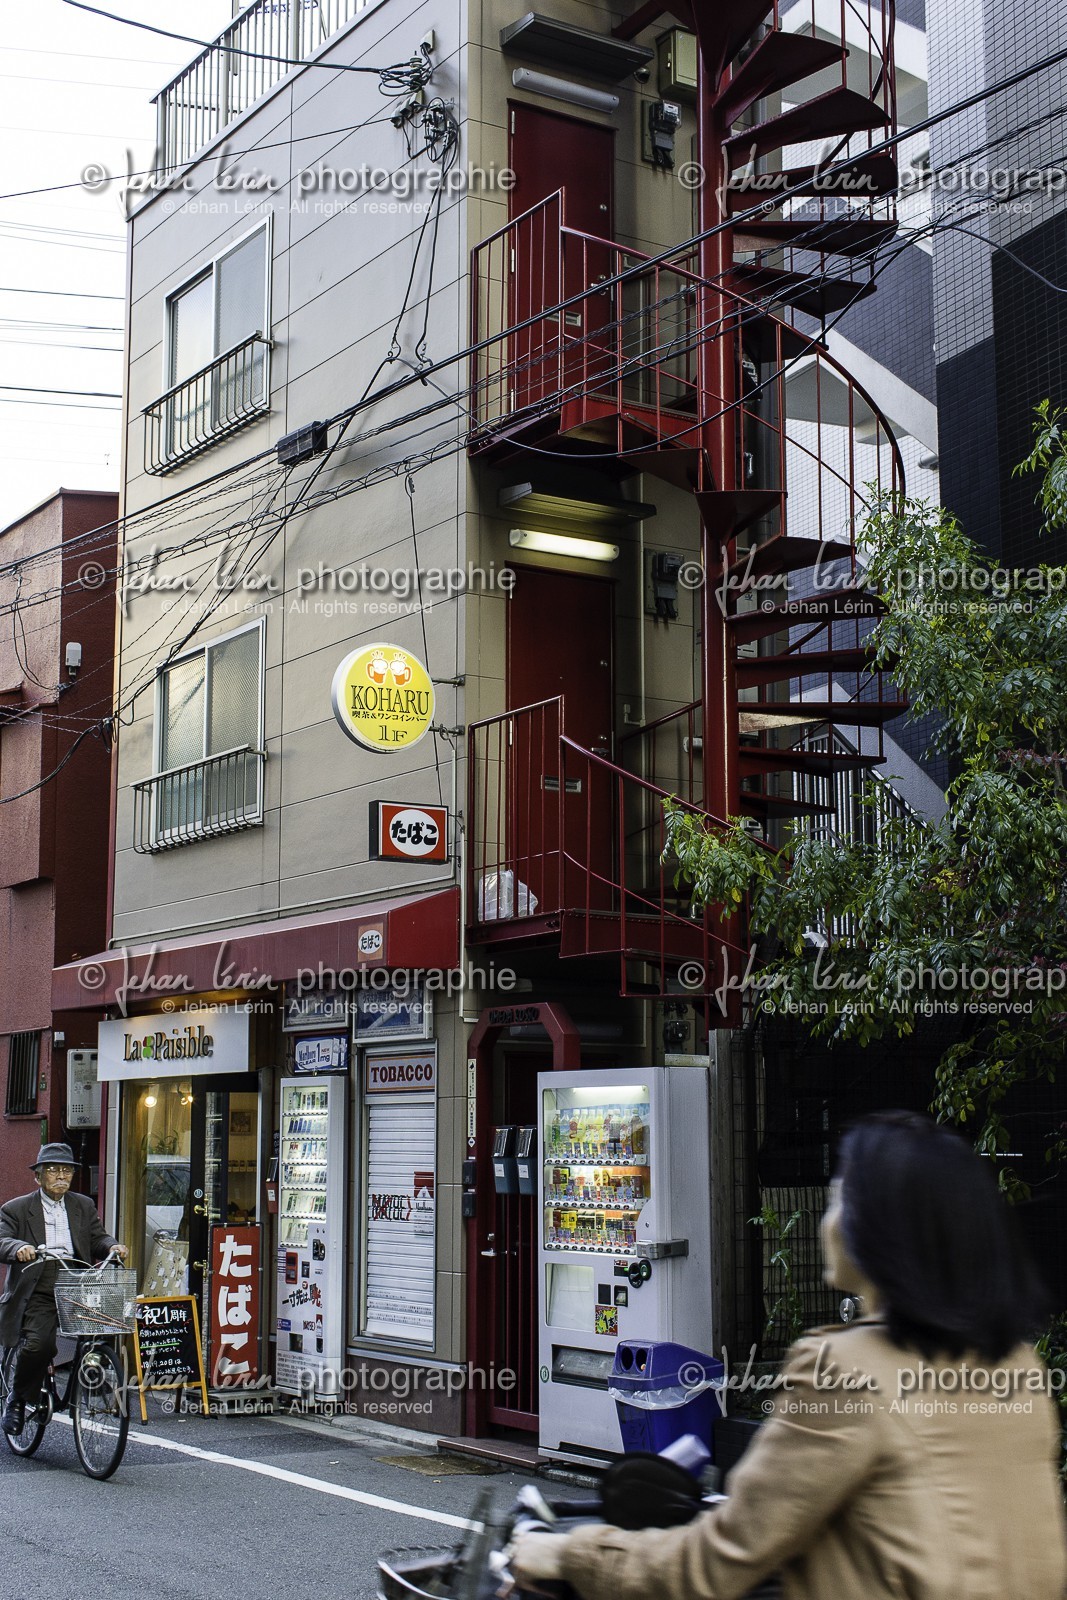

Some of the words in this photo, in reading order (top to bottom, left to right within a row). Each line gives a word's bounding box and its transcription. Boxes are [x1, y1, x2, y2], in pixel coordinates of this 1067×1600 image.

[351, 685, 430, 715] KOHARU
[378, 725, 407, 742] 1F
[391, 820, 437, 846] たばこ
[361, 934, 380, 950] たばこ
[123, 1033, 142, 1061] La
[154, 1025, 212, 1061] Paisible
[370, 1063, 433, 1083] TOBACCO
[142, 1305, 187, 1325] 祝1周年
[218, 1234, 252, 1375] たばこ
